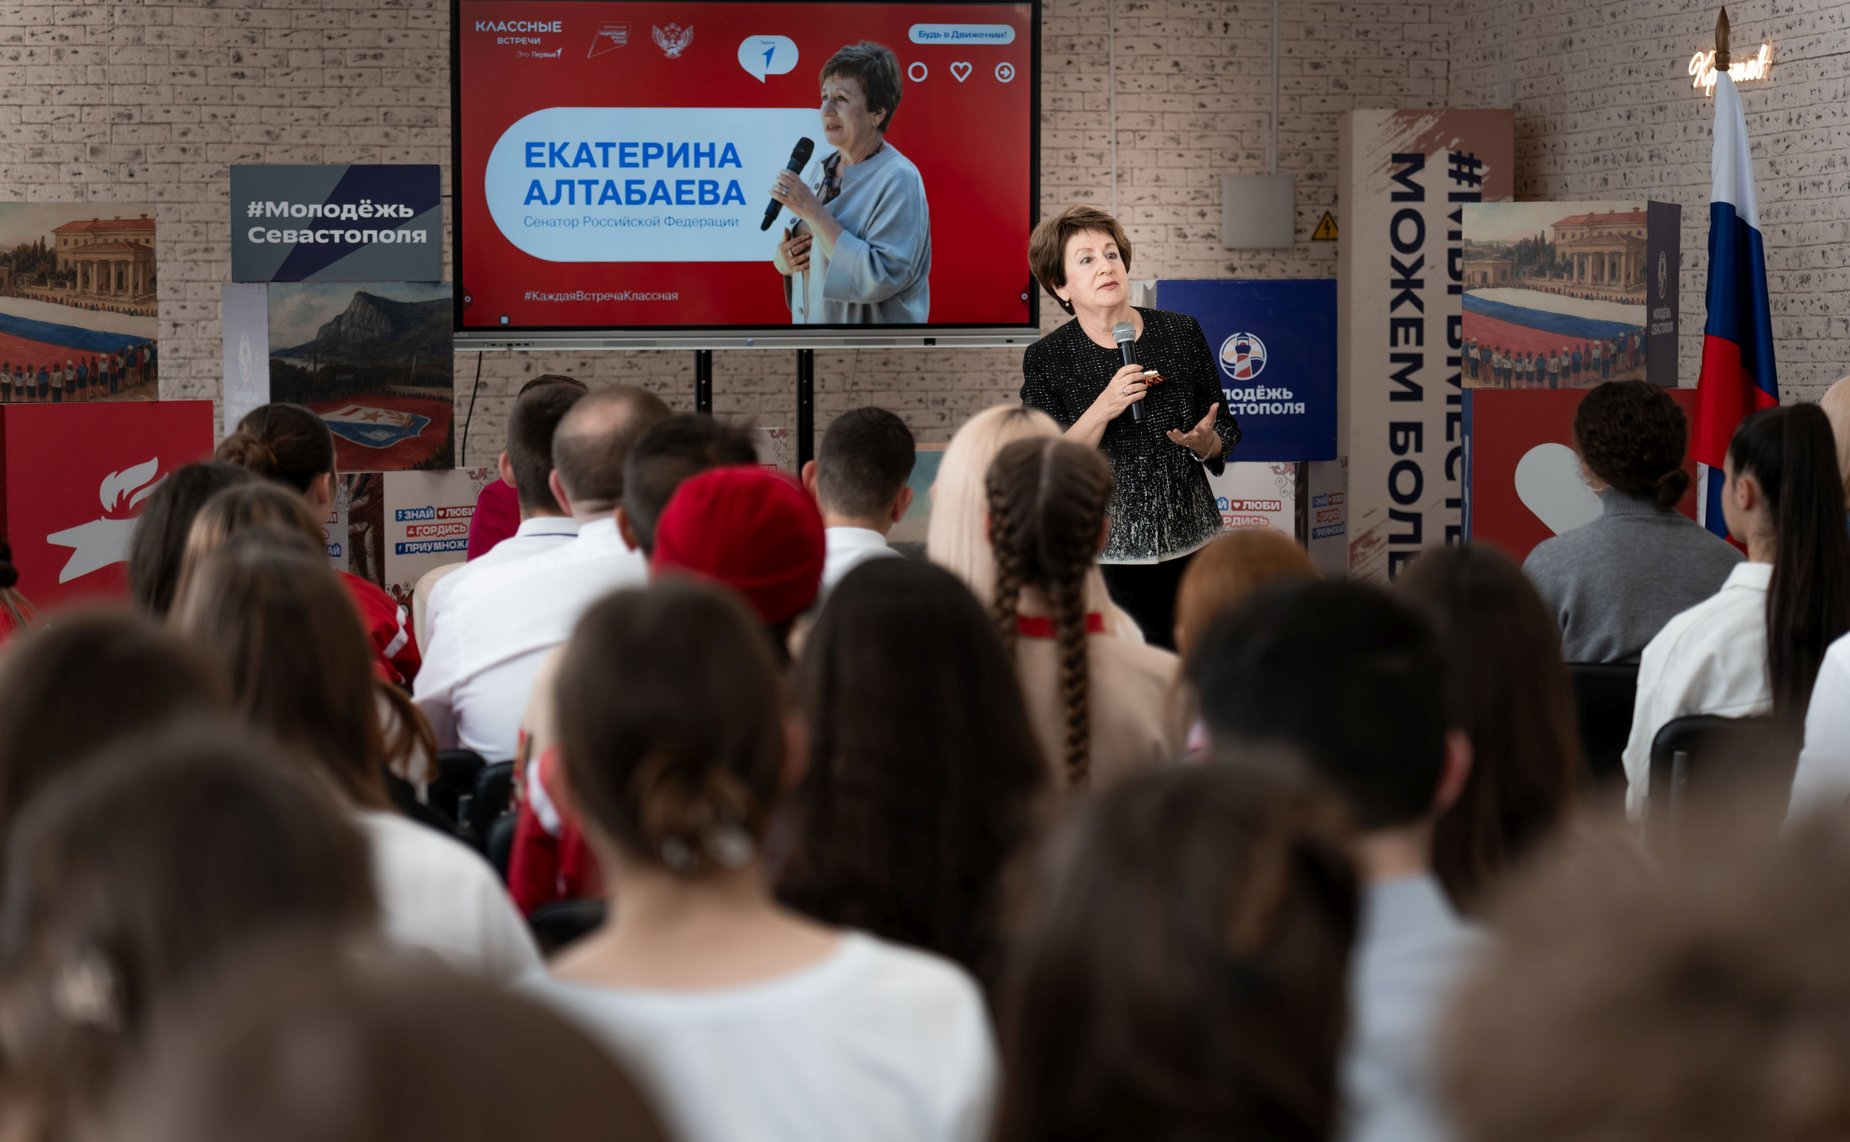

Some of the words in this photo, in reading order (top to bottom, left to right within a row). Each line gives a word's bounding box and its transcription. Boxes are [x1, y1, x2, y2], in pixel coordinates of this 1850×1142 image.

[475, 20, 562, 33] КЛАССНЫЕ
[497, 37, 541, 45] ВСТРЕЧИ
[918, 30, 942, 40] Будь
[951, 30, 1008, 40] Движении!
[525, 142, 743, 168] ЕКАТЕРИНА
[523, 179, 747, 206] АЛТАБАЕВА
[247, 199, 414, 221] #Молодёжь
[523, 216, 580, 229] Сенатор
[583, 216, 661, 227] Российской
[664, 216, 739, 229] Федерации
[247, 226, 427, 244] Севастополя
[1388, 152, 1426, 403] МОЖЕМ
[524, 291, 678, 302] #КаждаяВстречаКлассная
[1222, 385, 1294, 402] ЛОДЁЖЬ
[1228, 402, 1306, 415] СТОПОЛЯ
[1242, 501, 1281, 511] ЛЮБИ
[1388, 421, 1424, 581] БОЛЬ
[404, 506, 434, 520] ЗНАЙ
[1223, 516, 1269, 526] РДИСЬ
[415, 523, 467, 537] ГОРДИСЬ
[405, 540, 468, 553] ПРИУМНОЖ
